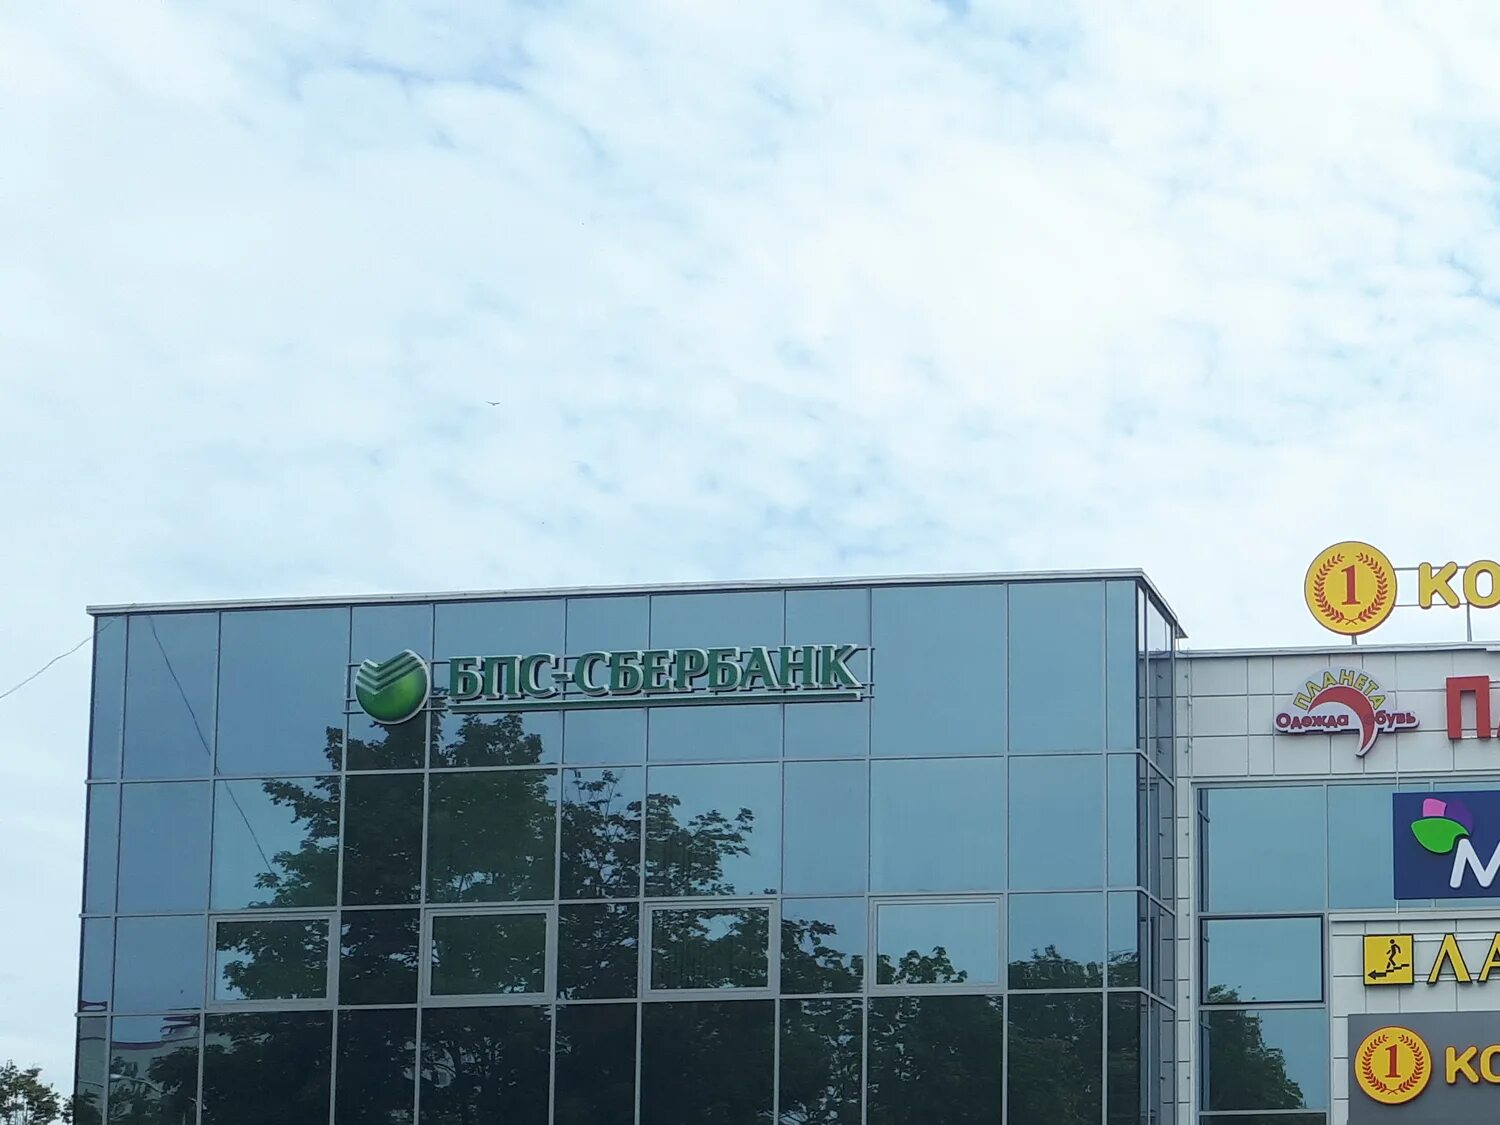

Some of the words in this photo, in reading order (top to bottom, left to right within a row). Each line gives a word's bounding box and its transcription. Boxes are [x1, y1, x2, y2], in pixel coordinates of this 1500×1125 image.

[1341, 564, 1361, 605] 1
[449, 643, 866, 701] БПС-СБЕРБАНК
[1293, 669, 1386, 711] ПЛАНЕТА
[1276, 712, 1349, 729] Одежда
[1385, 1043, 1402, 1079] 1
